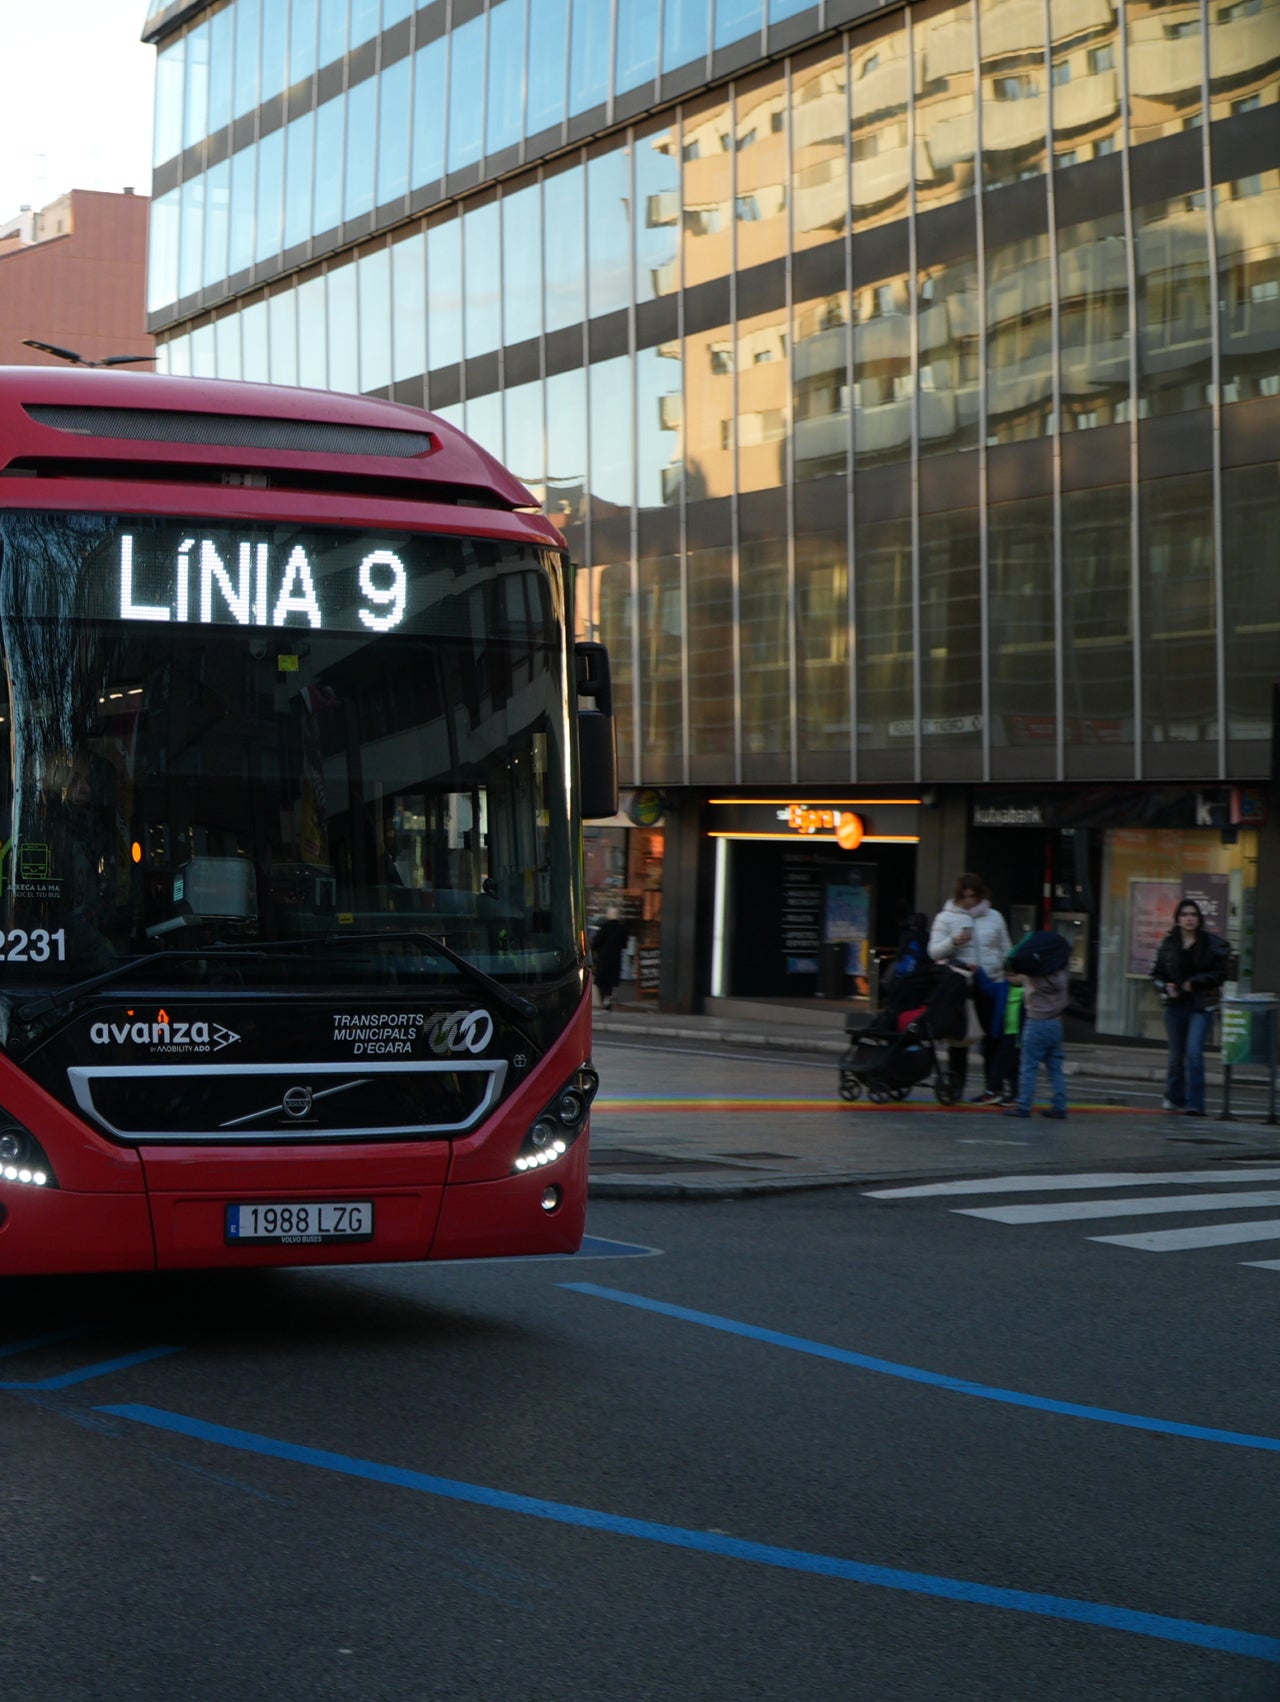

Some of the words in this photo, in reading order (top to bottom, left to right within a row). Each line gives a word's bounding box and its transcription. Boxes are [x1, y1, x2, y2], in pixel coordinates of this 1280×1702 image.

[358, 550, 406, 631] 9
[333, 1014, 424, 1026] TRANSPORTS
[90, 1022, 210, 1044] avanza
[333, 1028, 417, 1040] MUNICIPALS
[353, 1042, 412, 1054] D'EGARA
[231, 1225, 237, 1233] E
[251, 1208, 309, 1234] 1988
[318, 1207, 362, 1233] LZG
[302, 1235, 322, 1243] BUSES
